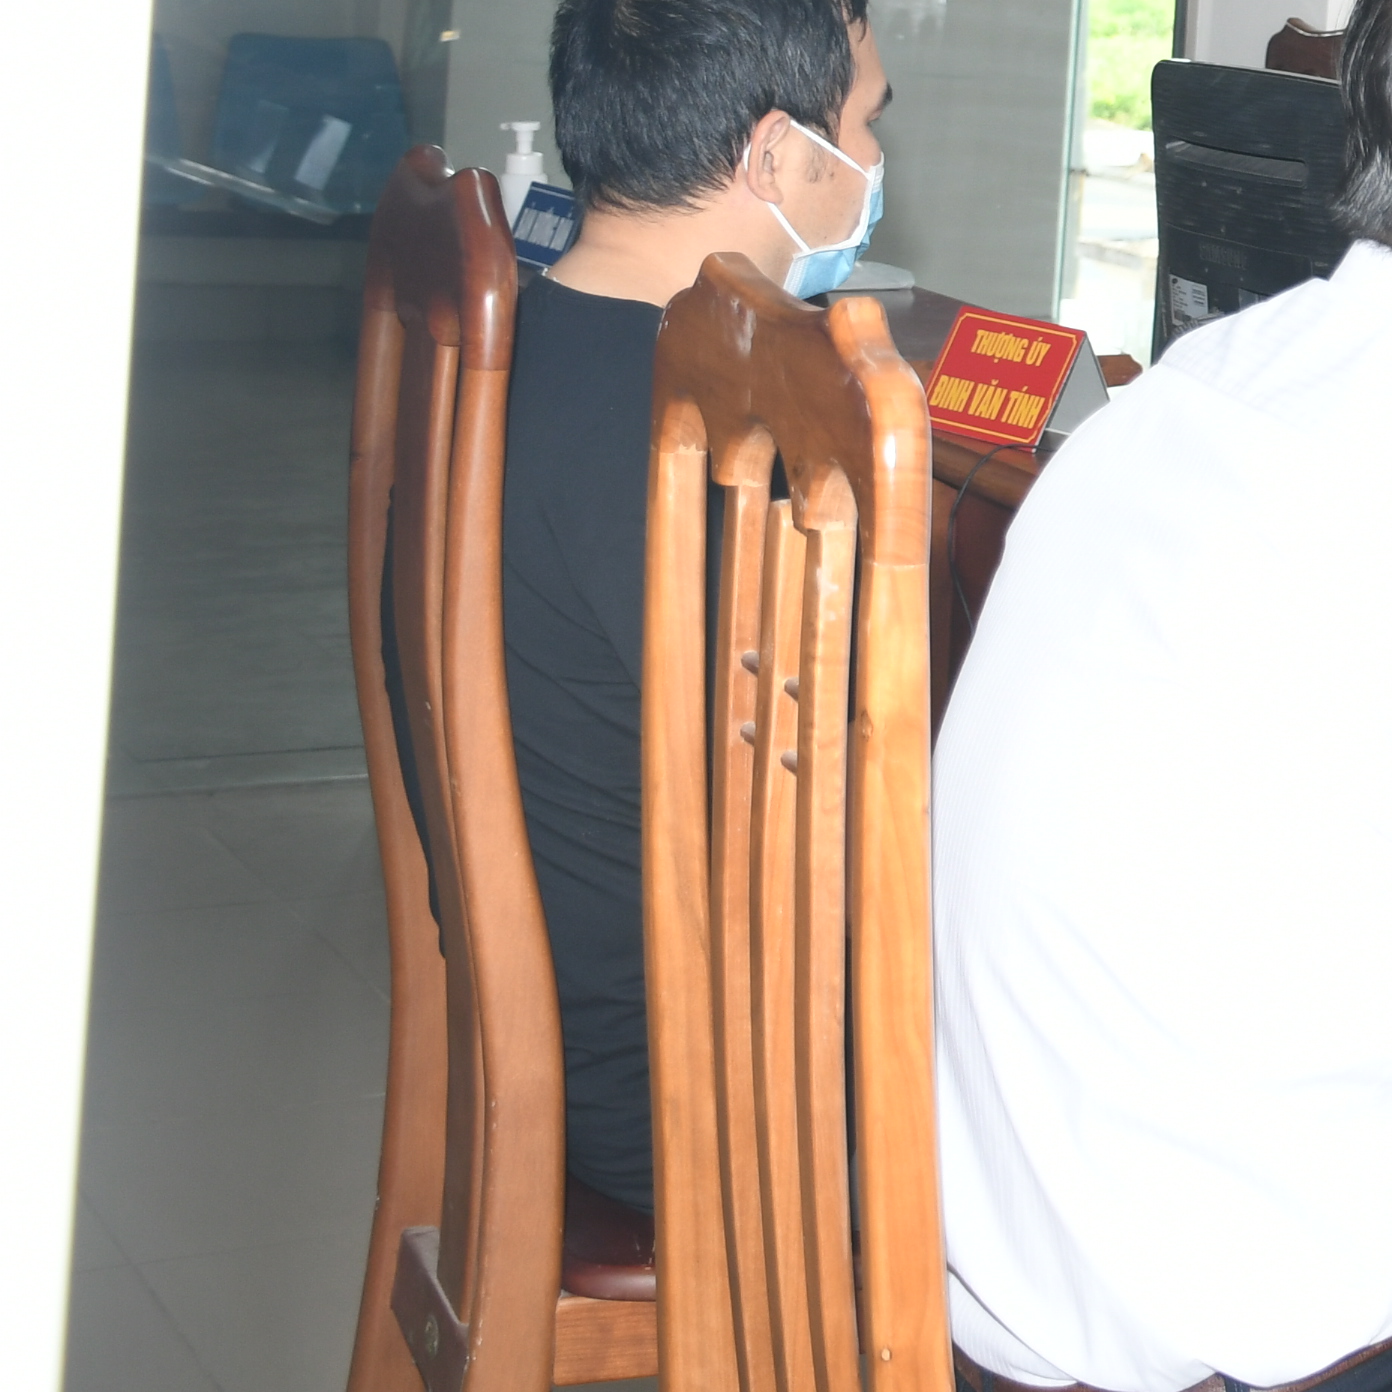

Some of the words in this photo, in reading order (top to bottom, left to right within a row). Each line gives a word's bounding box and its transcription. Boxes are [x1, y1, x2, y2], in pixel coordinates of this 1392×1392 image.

[970, 329, 1030, 364] THƯỢNG
[1025, 336, 1052, 367] ÚY
[967, 379, 1009, 421] VĂN
[1000, 385, 1046, 429] TÍNH
